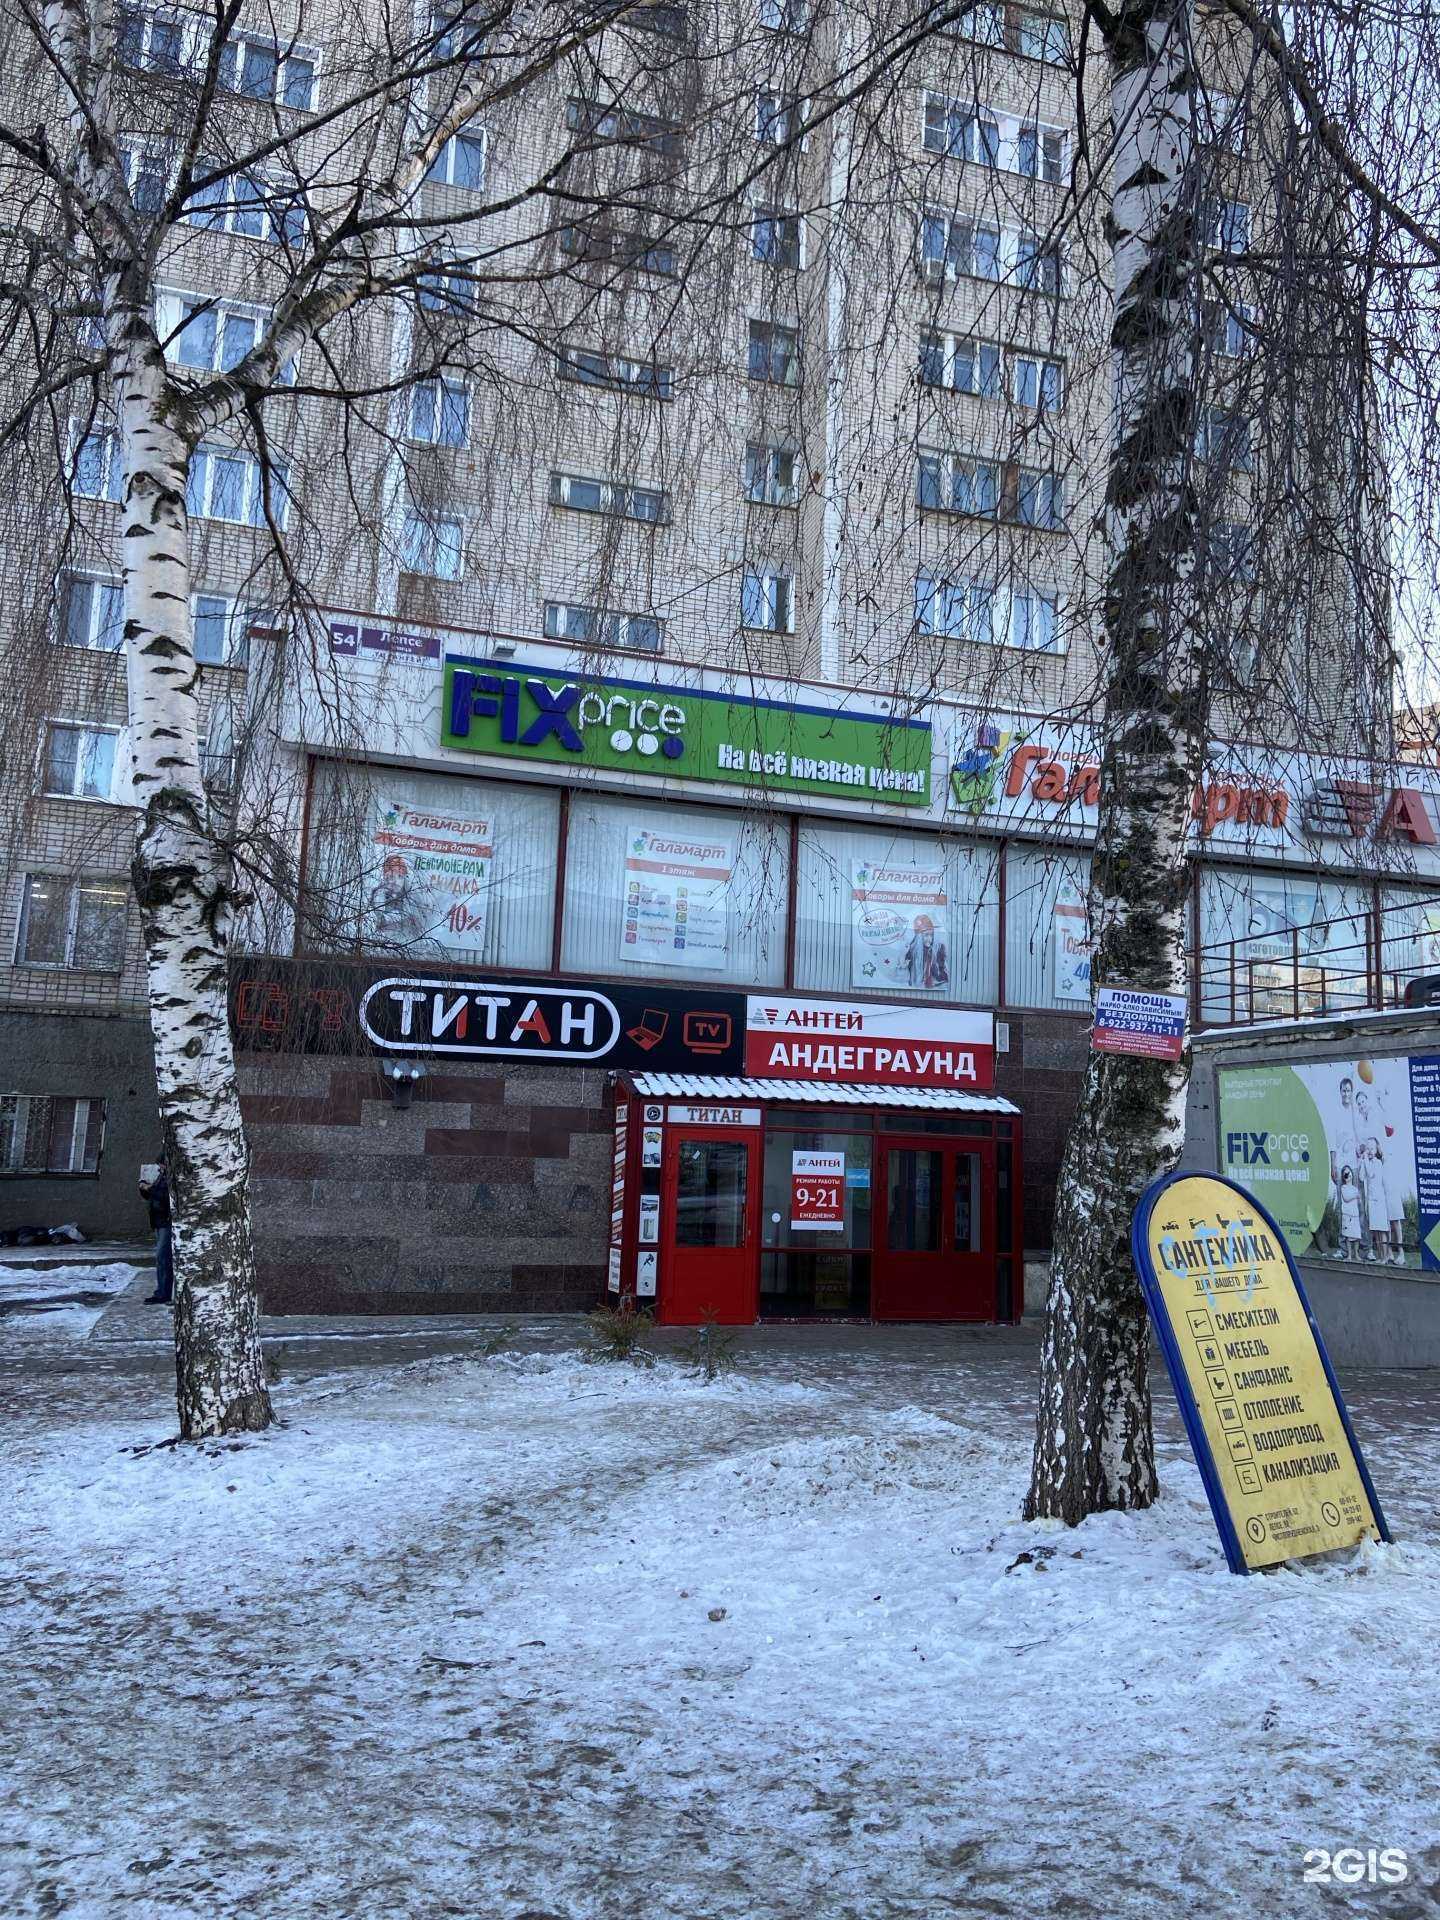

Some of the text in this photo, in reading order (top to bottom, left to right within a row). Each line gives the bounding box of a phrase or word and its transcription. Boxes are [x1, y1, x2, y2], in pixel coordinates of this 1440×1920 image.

[332, 632, 356, 647] 54
[380, 632, 423, 648] Лепсе
[578, 690, 686, 734] price
[717, 743, 926, 793] На всё низкая цена!
[401, 811, 487, 836] Галамарт
[391, 835, 428, 850] Товары
[430, 842, 448, 851] для
[648, 838, 726, 861] Галамарт
[414, 856, 484, 878] ПЕНСИОНЕРАМ
[871, 868, 942, 888] Галамарт
[912, 895, 935, 903] дома
[447, 903, 482, 933] 10%
[1112, 992, 1172, 1009] ПОМОЩЬ
[389, 991, 594, 1045] ТИТАН
[785, 1009, 863, 1031] АНТЕЙ
[1099, 1018, 1178, 1036] 8-922-937-11-11
[1105, 1010, 1174, 1025] БЕЗДОМНЫМ
[696, 1022, 720, 1038] TV
[768, 1042, 977, 1080] АНДЕГРАУНД
[687, 1107, 743, 1123] ТИТАН
[1268, 1133, 1309, 1152] price
[808, 1158, 841, 1168] АНТЕЙ
[796, 1177, 817, 1185] РЕЖИМ
[796, 1188, 839, 1208] 9-21
[1157, 1234, 1276, 1270] САНТЕХНИКА
[1214, 1276, 1241, 1289] ВАШЕГО
[1244, 1274, 1263, 1286] ДОМА
[1215, 1308, 1280, 1331] СМЕСИТЕЛИ
[1224, 1339, 1270, 1360] МЕБЕЛЬ
[1234, 1366, 1293, 1390] САНФАЯНС
[1243, 1395, 1305, 1421] ОТОПЛЕНИЕ
[1252, 1423, 1325, 1452] ВОДОПРОВОД
[1262, 1452, 1341, 1483] КАНАЛИЗАЦИЯ
